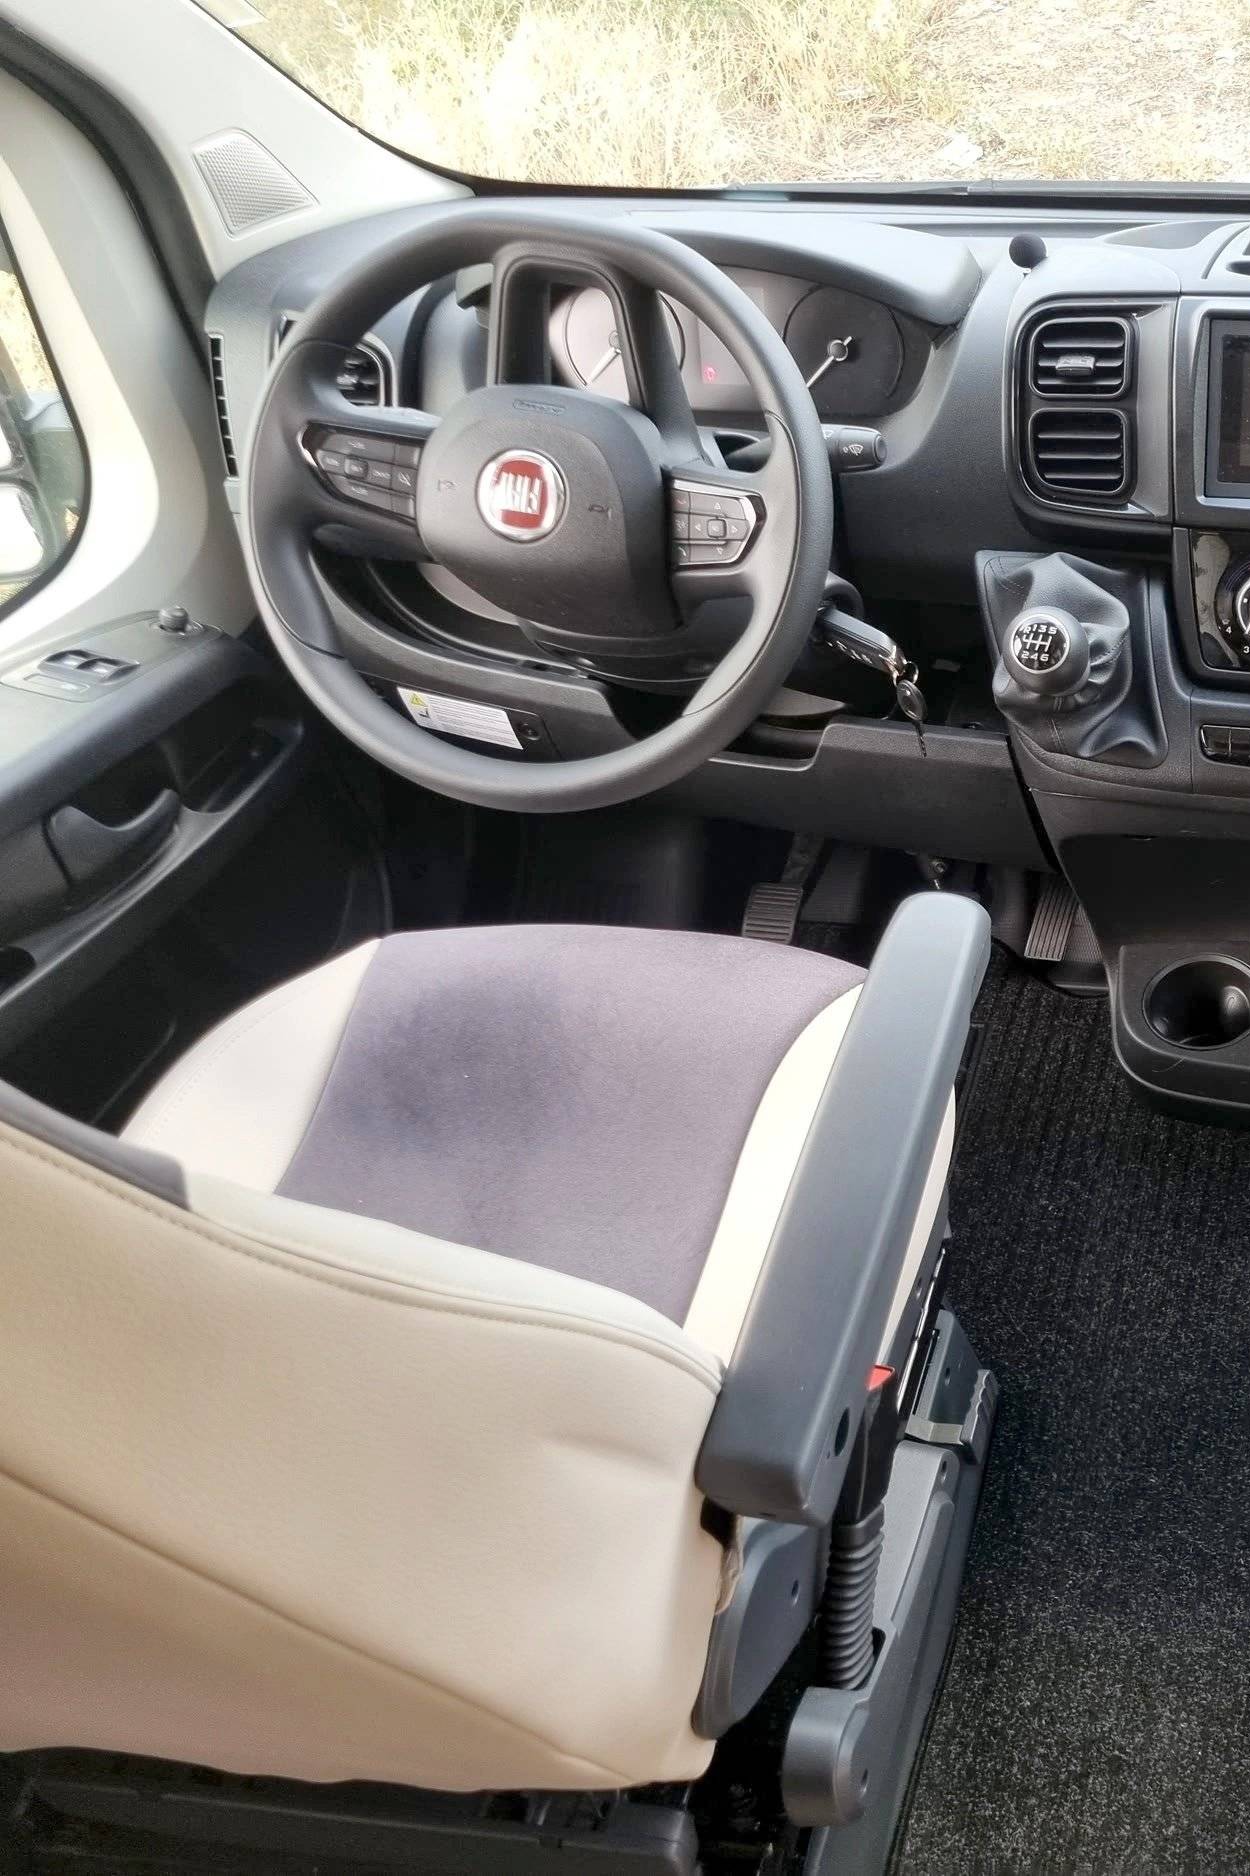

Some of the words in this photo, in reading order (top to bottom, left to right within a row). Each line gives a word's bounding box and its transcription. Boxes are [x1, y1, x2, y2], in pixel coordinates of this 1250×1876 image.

[1023, 626, 1031, 634] R
[1038, 624, 1048, 633] 3
[1048, 626, 1058, 635] 5
[1225, 626, 1232, 634] 4
[1243, 645, 1250, 654] 3
[1021, 650, 1029, 659] 2
[1030, 652, 1039, 660] 4
[1040, 653, 1050, 662] 6
